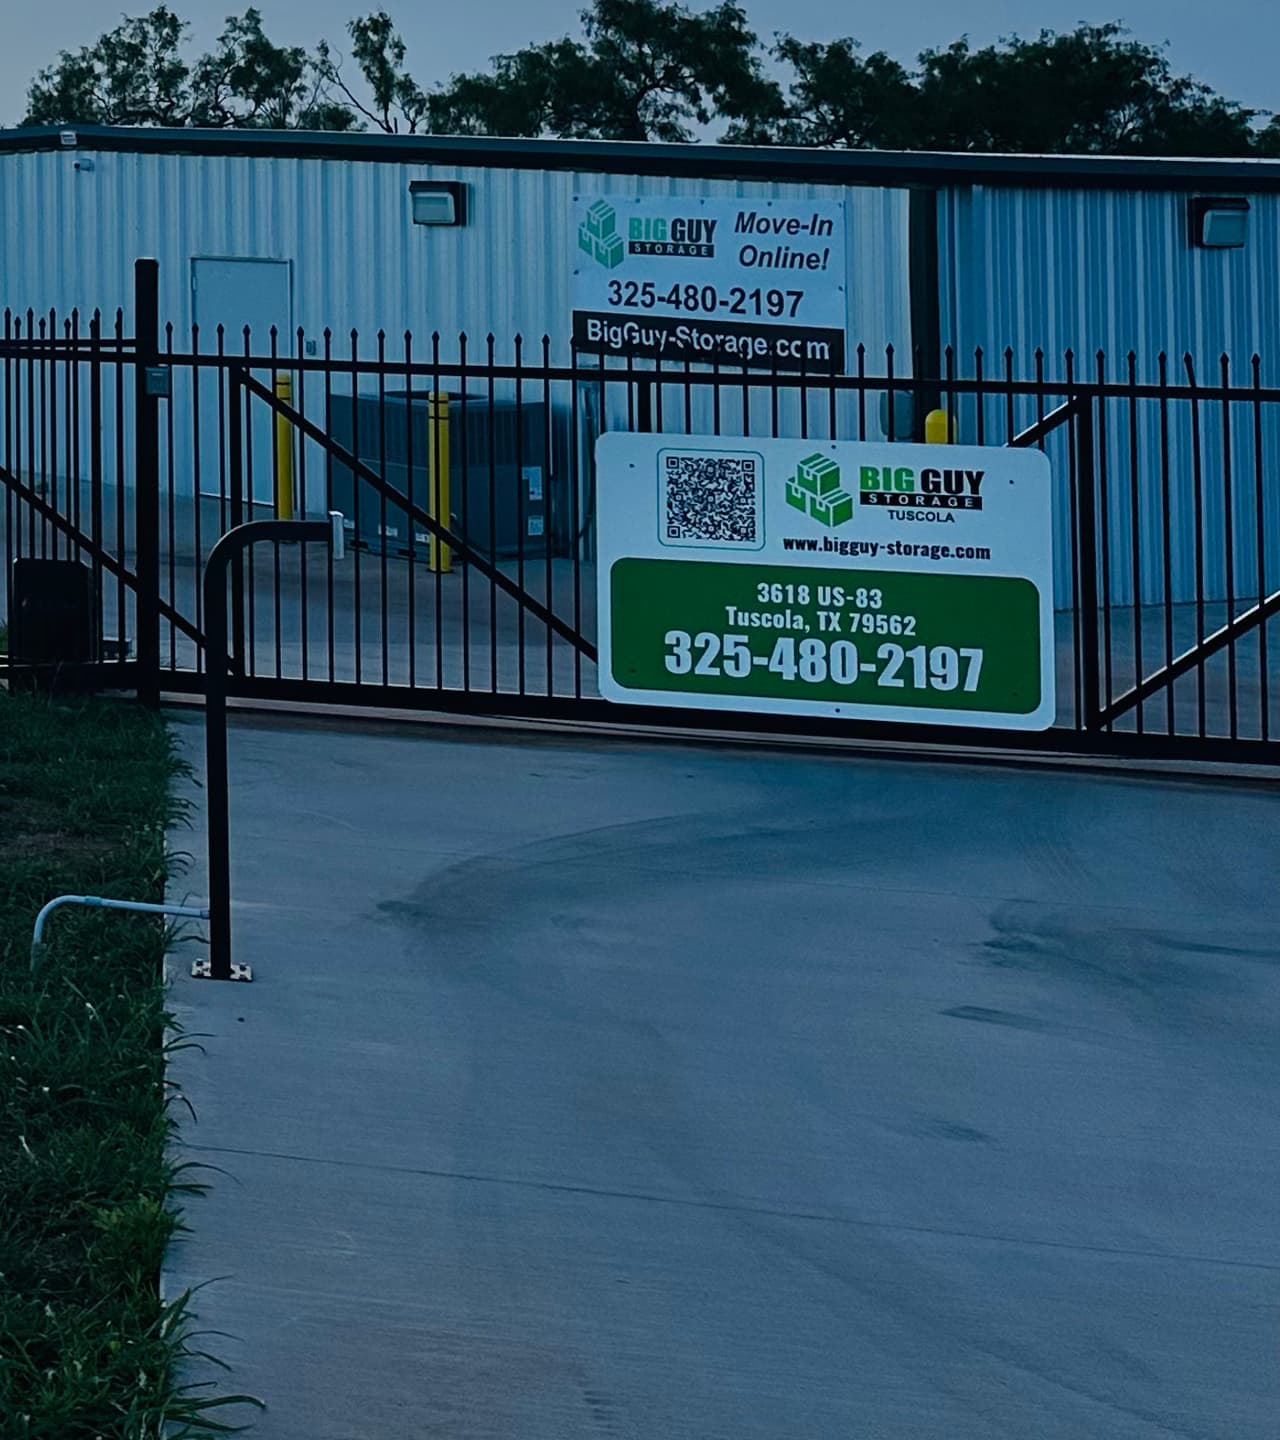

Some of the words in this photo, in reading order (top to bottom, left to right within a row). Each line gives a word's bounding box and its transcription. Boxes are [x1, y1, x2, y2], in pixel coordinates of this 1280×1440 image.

[628, 217, 667, 241] BIG
[671, 218, 717, 243] GUY
[734, 211, 834, 237] Move-In
[634, 244, 709, 256] STORAGE
[739, 245, 830, 270] Online!
[608, 280, 804, 317] 325-480-2197
[859, 466, 915, 492] BIG
[921, 468, 985, 495] GUY
[868, 494, 975, 508] STORAGE
[888, 510, 955, 523] TUSCOLA
[783, 537, 991, 560] www.bigguy-storage.com
[757, 583, 810, 605] 3618
[818, 586, 883, 608] US-83
[725, 606, 810, 633] Tuscola,
[817, 612, 842, 633] TX
[849, 614, 917, 636] 79562
[664, 630, 984, 692] 325-480-2197
